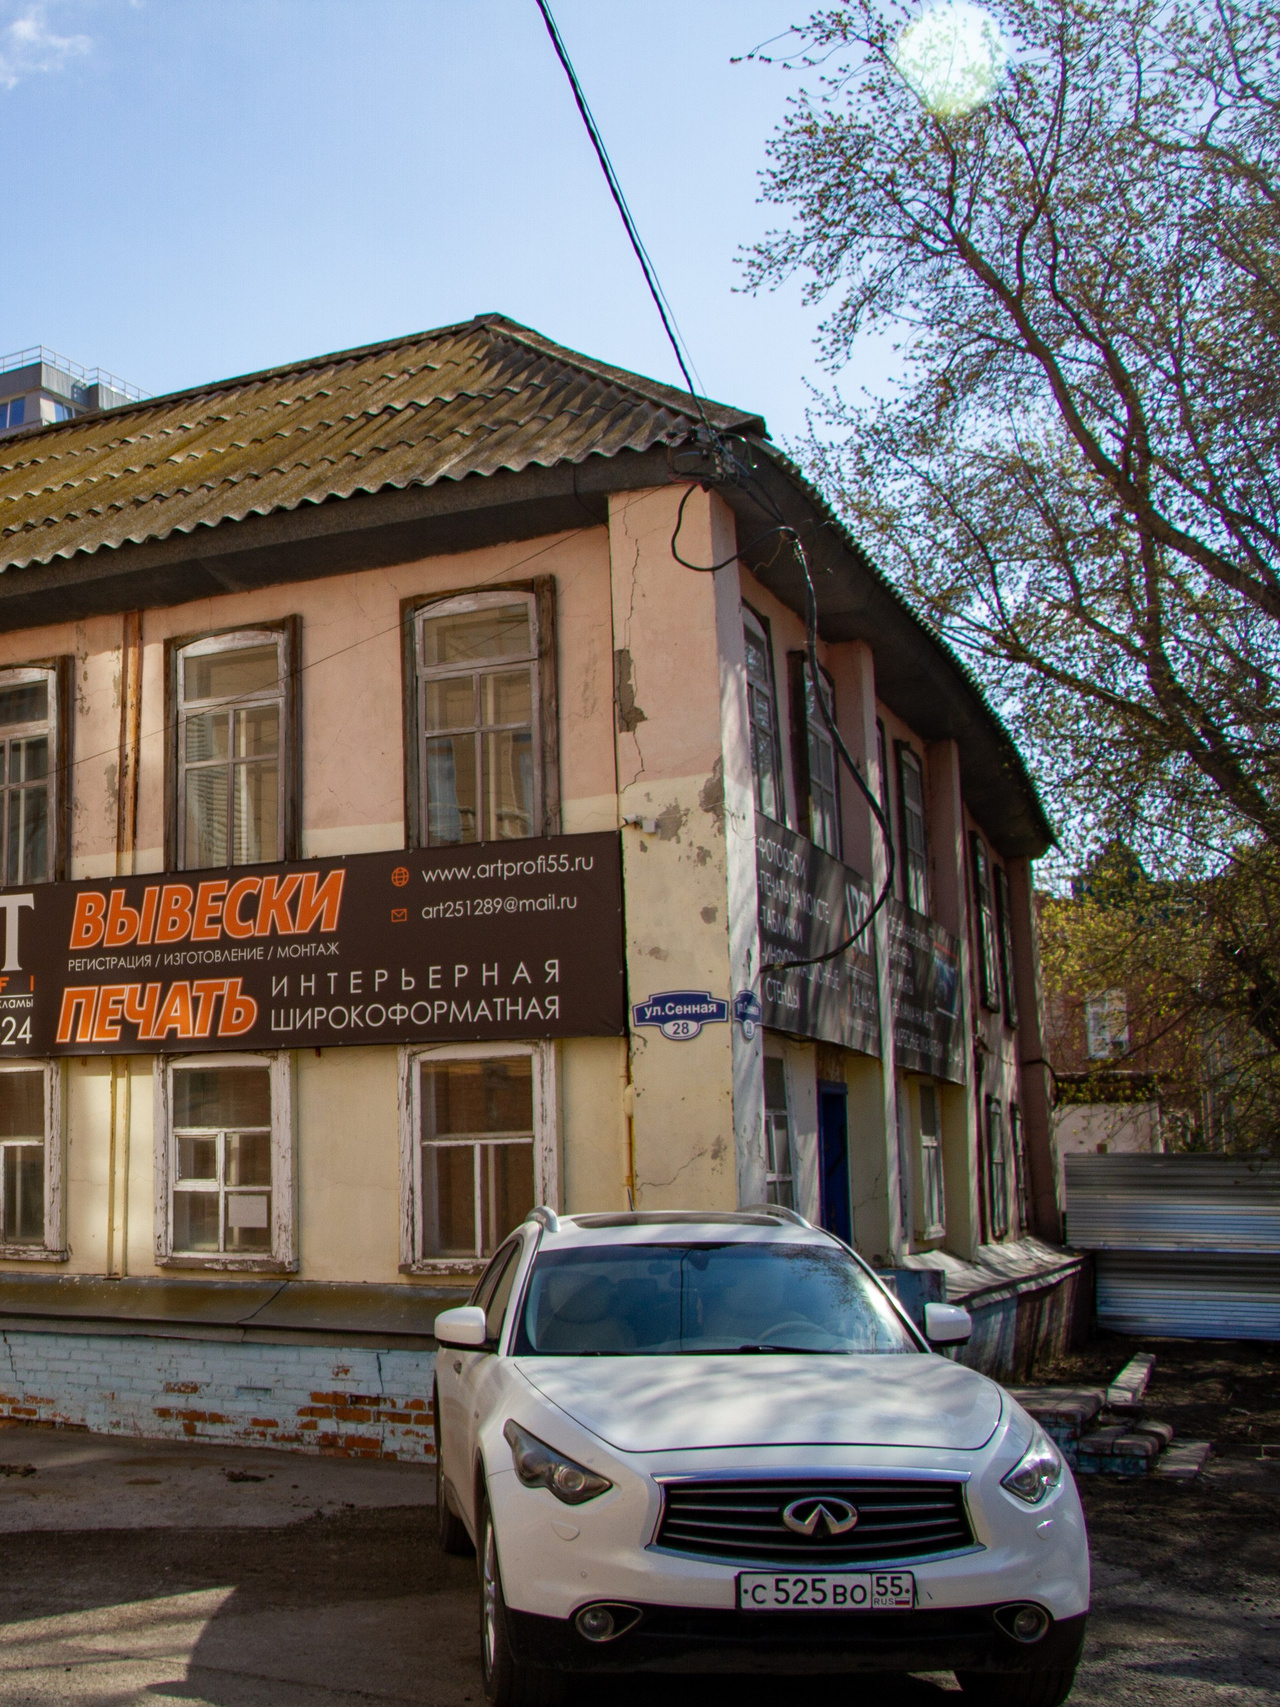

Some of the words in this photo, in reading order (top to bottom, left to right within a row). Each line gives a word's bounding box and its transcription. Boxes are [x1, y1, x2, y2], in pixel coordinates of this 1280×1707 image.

[421, 854, 594, 882] www.artprofi55.ru
[68, 867, 346, 950] ВЫВЕСКИ
[421, 894, 577, 920] art251289@mail.ru
[68, 955, 151, 972] РЕГИСТРАЦИЯ
[164, 946, 264, 966] ИЗГОТОВЛЕНИЕ
[277, 941, 339, 959] МОНТАЖ
[272, 959, 560, 997] ИНТЕРЬЕРНАЯ
[55, 977, 258, 1043] ПЕЧАТЬ
[271, 995, 560, 1032] ШИРОКОФОРМАТНАЯ
[644, 1002, 717, 1019] ул.Сенная
[672, 1022, 690, 1035] 28
[873, 1597, 895, 1606] RUS
